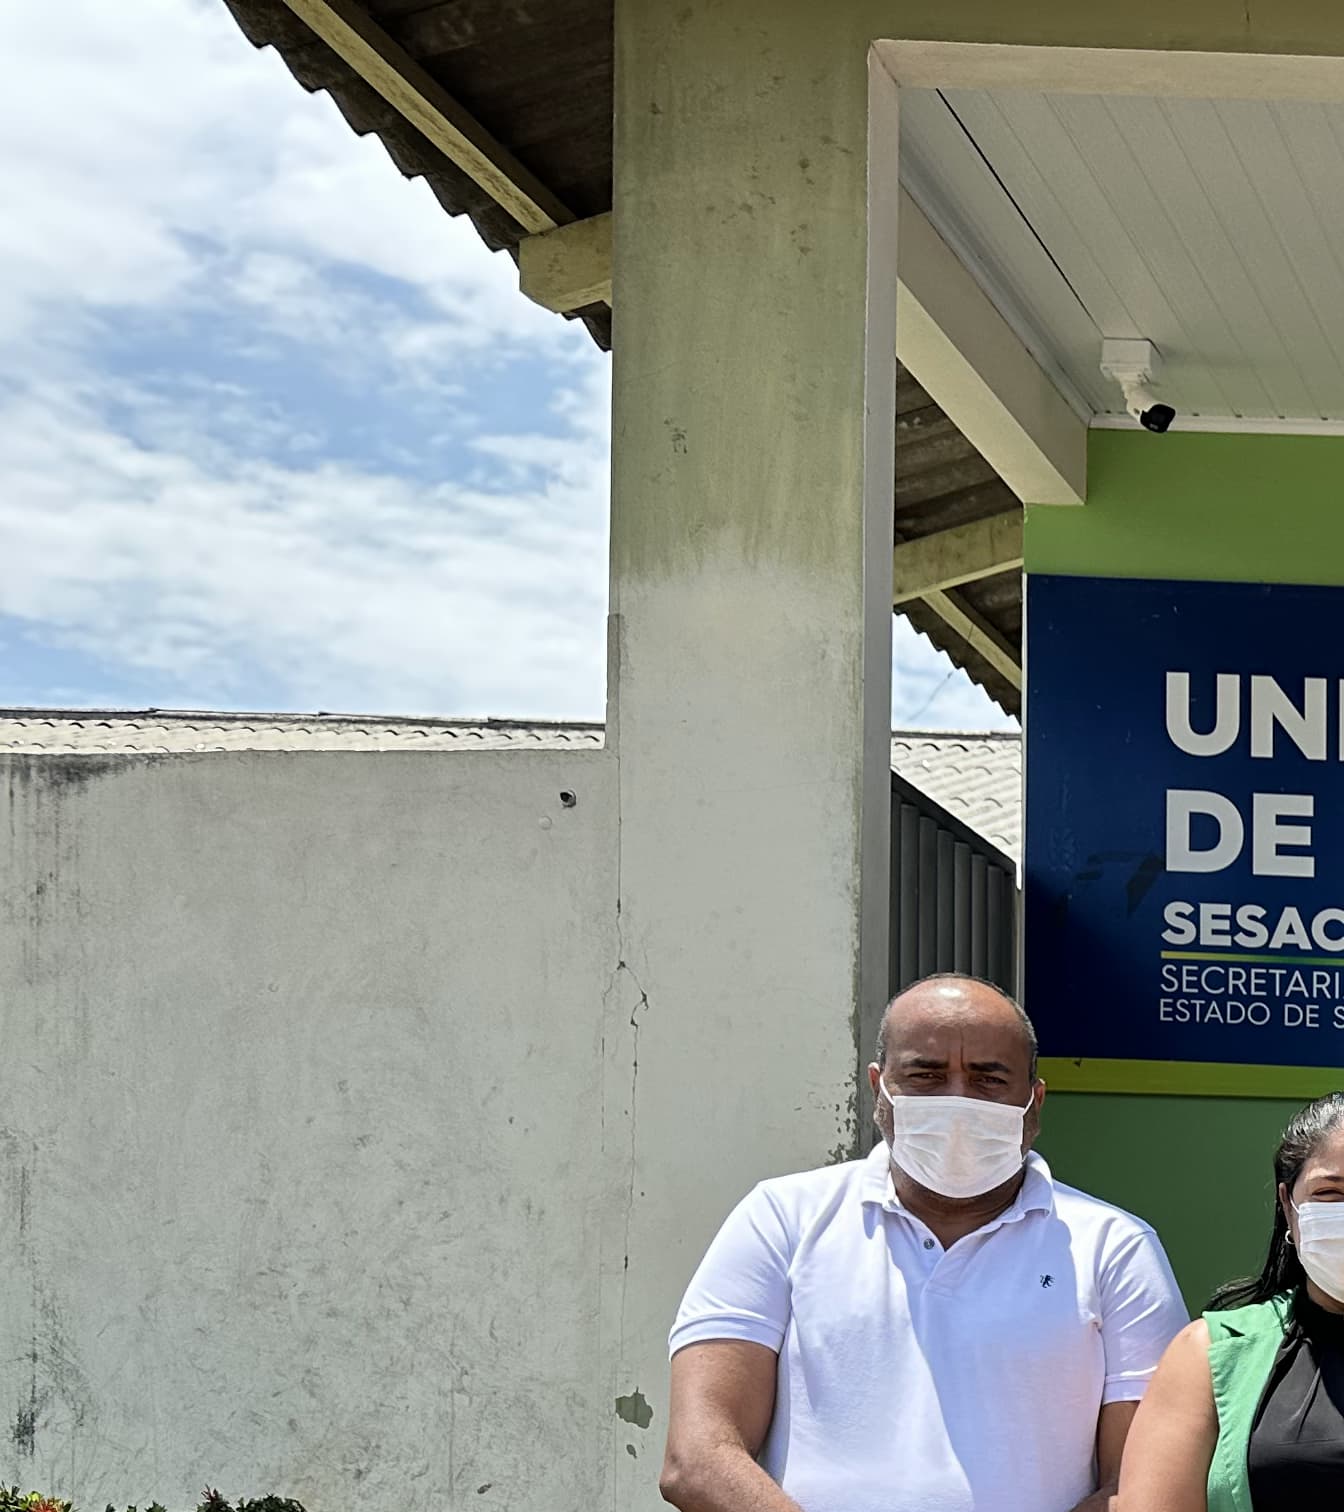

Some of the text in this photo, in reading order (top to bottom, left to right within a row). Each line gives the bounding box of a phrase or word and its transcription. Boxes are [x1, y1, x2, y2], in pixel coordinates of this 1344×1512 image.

[1166, 789, 1315, 878] DE
[1160, 998, 1271, 1025] ESTADO
[1284, 1004, 1320, 1028] DE
